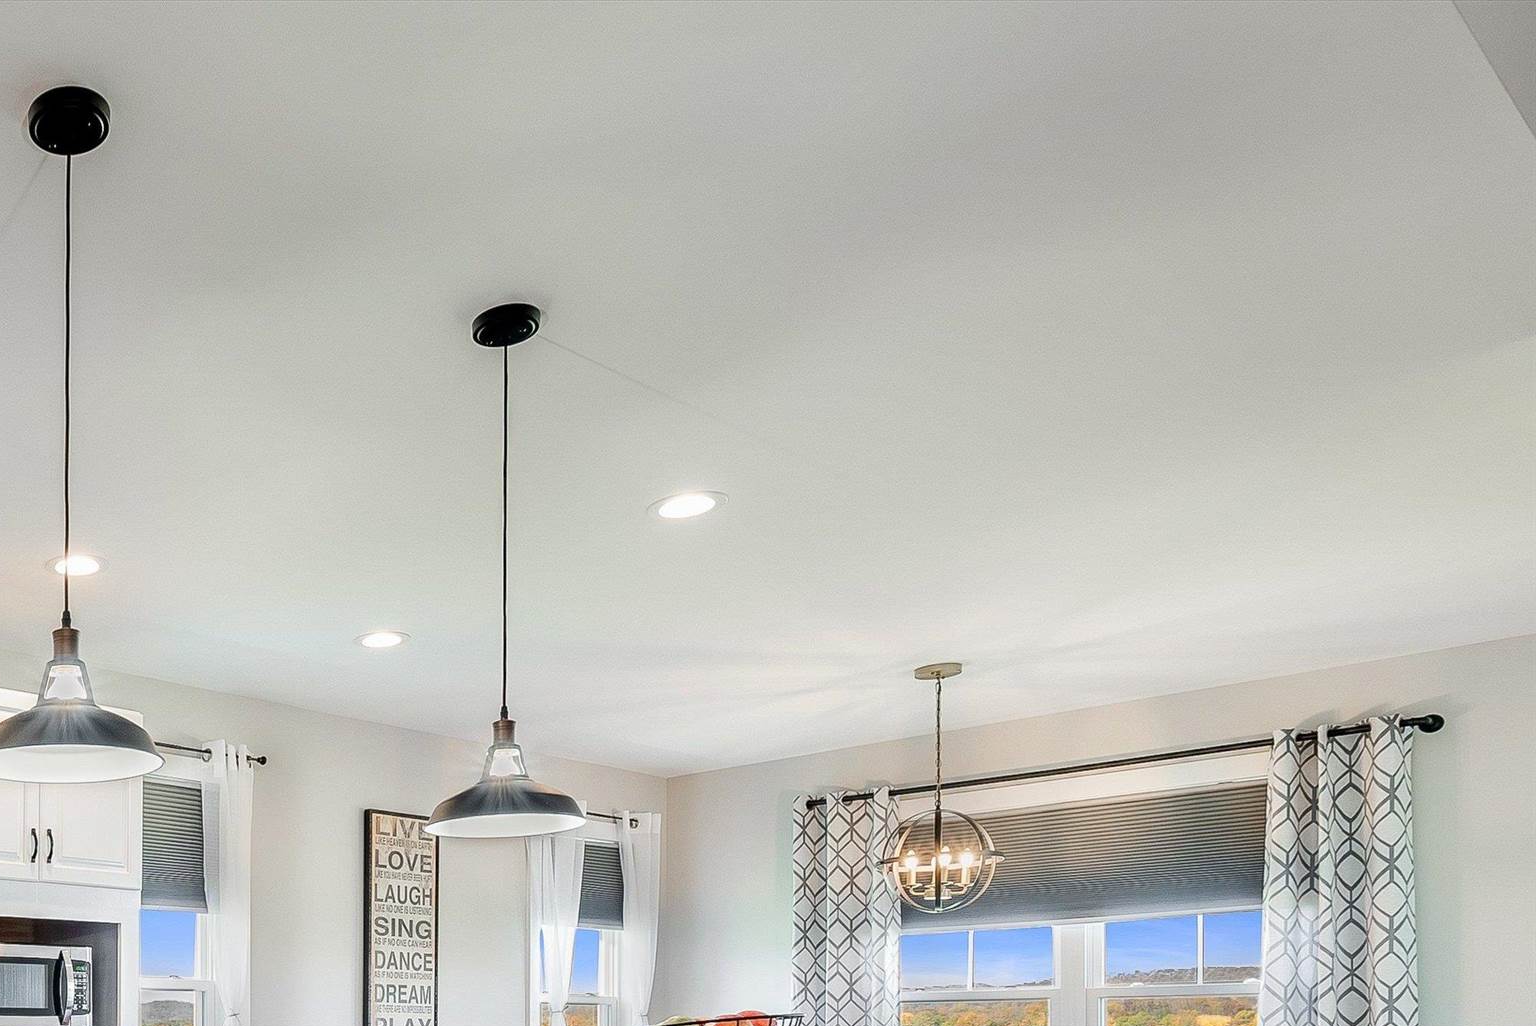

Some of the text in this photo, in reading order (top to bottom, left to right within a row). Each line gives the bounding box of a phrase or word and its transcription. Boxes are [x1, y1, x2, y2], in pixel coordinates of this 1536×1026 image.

[375, 815, 433, 842] LIVE
[375, 848, 432, 873] LOVE
[374, 883, 432, 907] LAUGH
[374, 916, 432, 940] SING
[374, 950, 432, 972] DANCE
[374, 983, 432, 1004] DREAM
